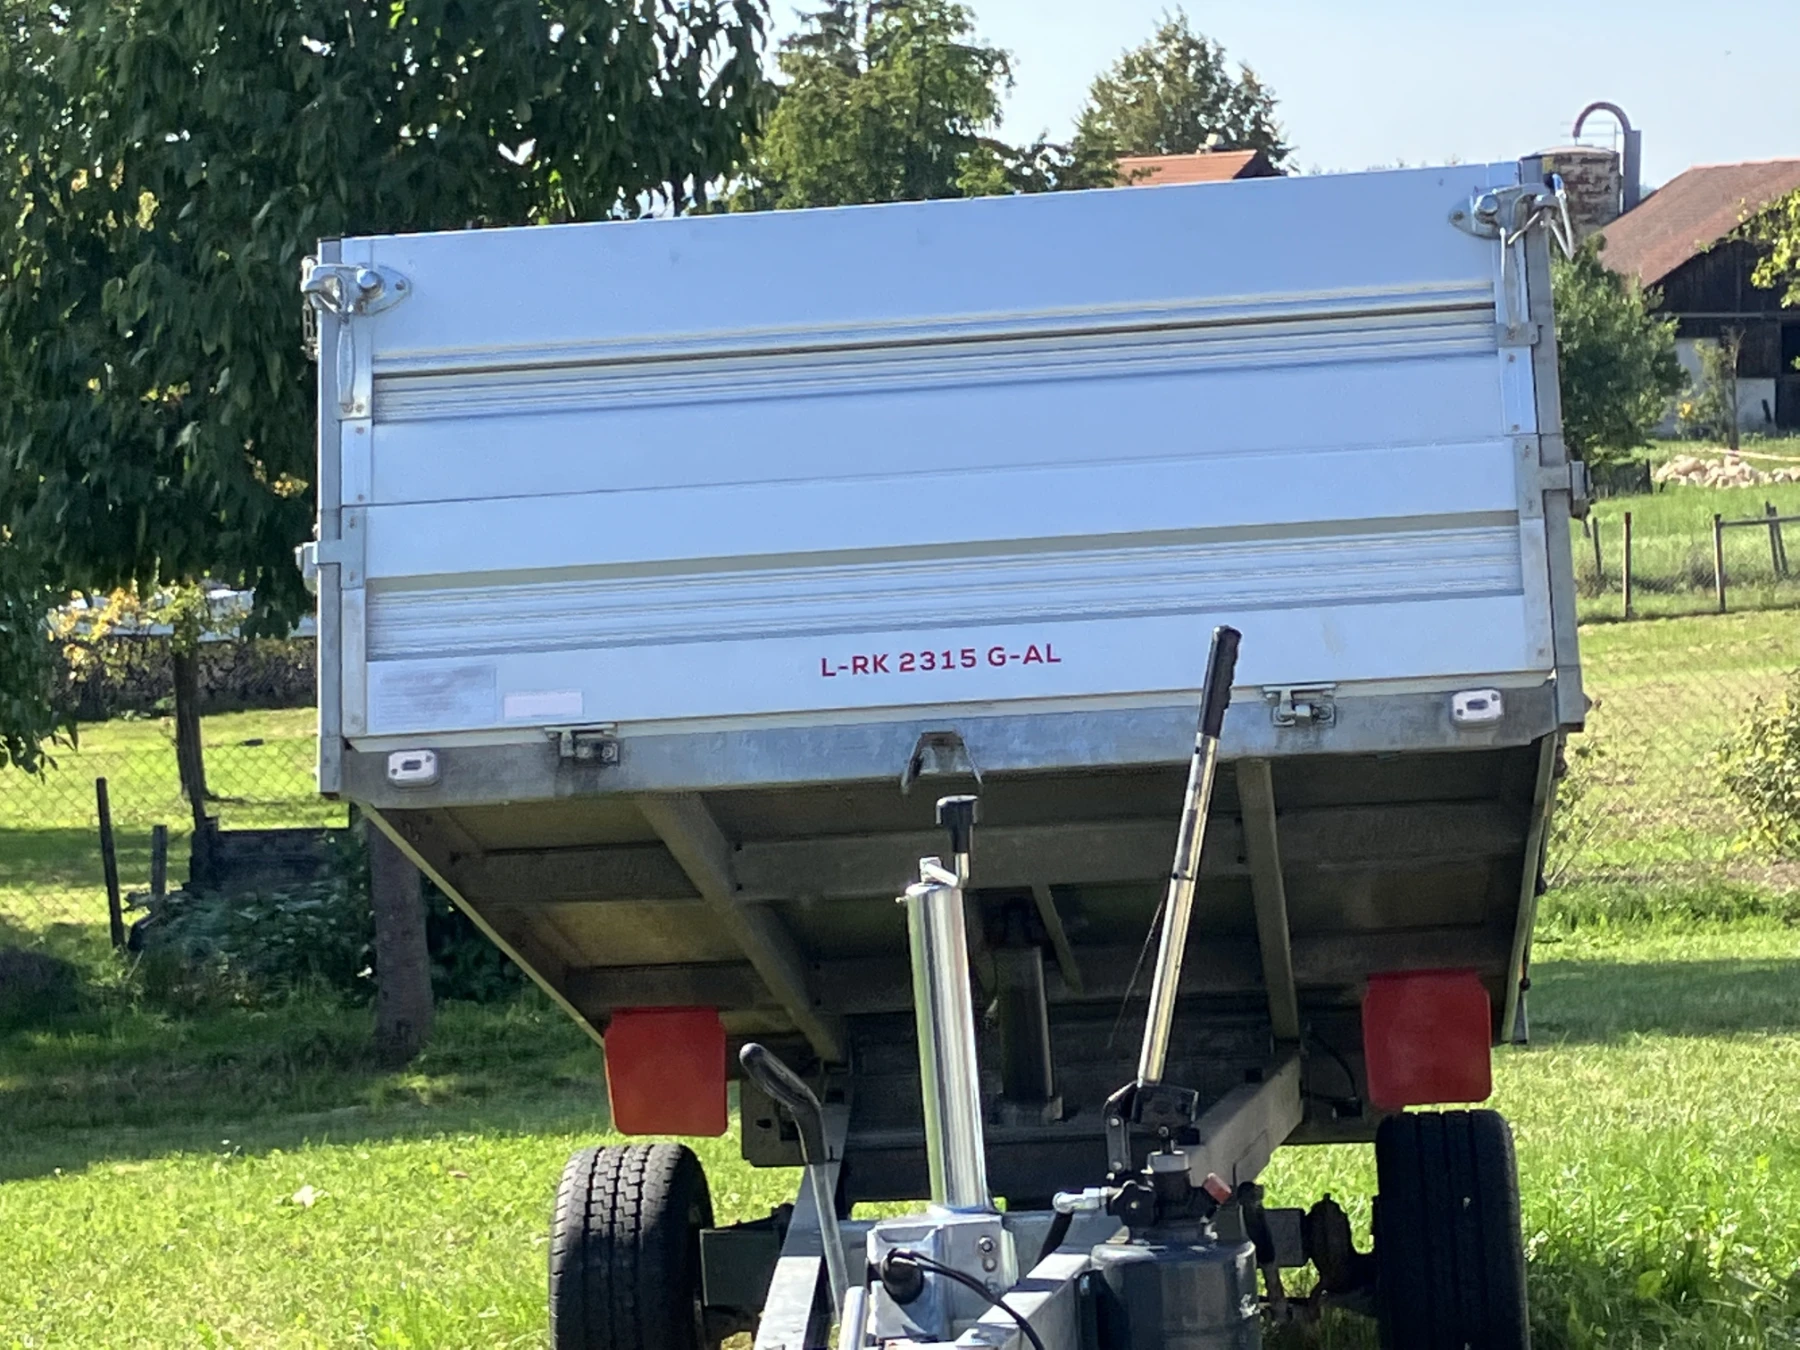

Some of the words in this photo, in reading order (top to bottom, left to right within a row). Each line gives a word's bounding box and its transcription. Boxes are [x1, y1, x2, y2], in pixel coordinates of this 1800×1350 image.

[821, 653, 890, 677] L-RK
[899, 648, 977, 673] 2315
[987, 643, 1062, 667] G-AL
